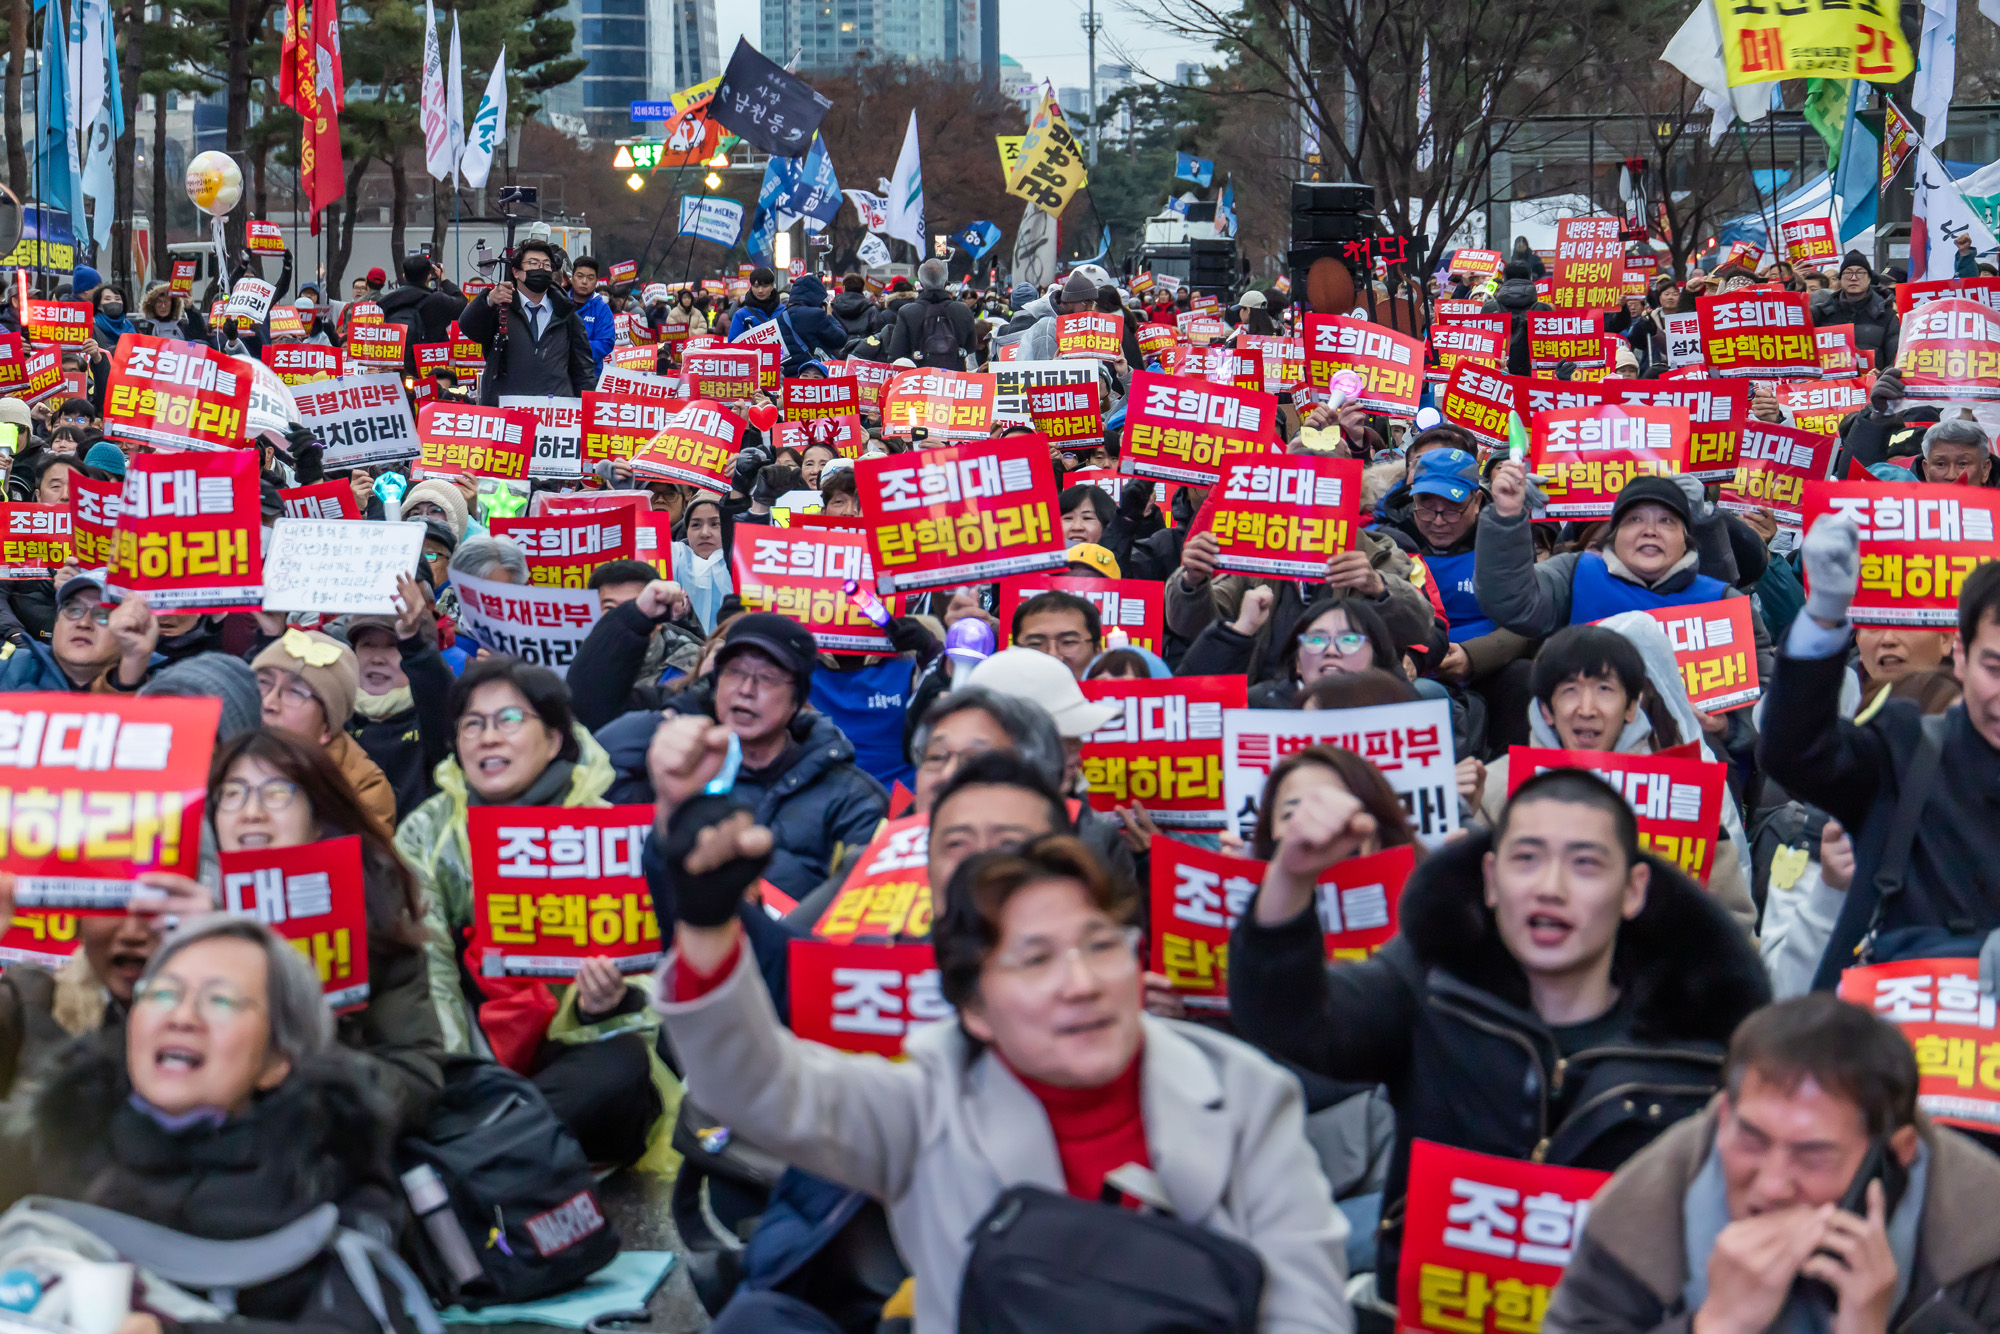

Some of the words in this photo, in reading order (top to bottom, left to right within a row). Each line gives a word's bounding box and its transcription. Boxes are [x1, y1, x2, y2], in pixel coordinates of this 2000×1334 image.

[756, 85, 780, 105] 사장
[634, 106, 661, 116] 지하차도
[735, 92, 784, 134] 남천동
[251, 237, 284, 249] 탄핵하라
[252, 224, 281, 235] 조희대
[1567, 222, 1595, 238] 내란당은
[1597, 221, 1619, 238] 국민을
[1344, 236, 1408, 269] 처단
[1459, 250, 1495, 261] 조희대를
[1560, 242, 1576, 259] 절대
[1578, 242, 1594, 259] 이길
[1595, 242, 1604, 259] 수
[1605, 241, 1622, 259] 없다
[1452, 260, 1494, 270] 탄핵하라!
[1565, 262, 1612, 282] 내란당이
[354, 305, 384, 316] 조희대
[1555, 287, 1573, 307] 퇴출
[32, 306, 85, 322] 조희대를
[1064, 317, 1117, 334] 조희대를
[1534, 317, 1594, 335] 조희대를
[1712, 301, 1804, 330] 조희대를
[1909, 311, 2000, 341] 조희대를
[29, 325, 88, 342] 탄핵하라!
[354, 326, 400, 341] 조희대를
[1060, 335, 1119, 352] 탄핵하라!
[1137, 327, 1171, 338] 조희대를
[1140, 338, 1175, 350] 탄핵하라!
[1315, 324, 1410, 365] 조희대를
[1433, 332, 1495, 353] 조희대를
[1817, 331, 1846, 348] 대를
[274, 351, 336, 369] 조희대를
[350, 344, 401, 359] 탄핵하라!
[616, 349, 652, 361] 조희대를
[1532, 339, 1600, 358] 탄핵하라!
[1708, 335, 1814, 363] 탄핵하라!
[1821, 350, 1852, 369] 하라!
[125, 345, 236, 396] 조희대를
[689, 359, 750, 376] 조희대를
[856, 366, 895, 383] 조희대
[299, 384, 399, 417] 특별재판부
[699, 382, 754, 399] 핵하라!
[790, 385, 851, 403] 조희대를
[899, 375, 983, 399] 조희대를
[1457, 367, 1515, 407] 조희대
[1788, 387, 1867, 411] 조희대를
[109, 384, 241, 439] 탄핵하라!
[890, 401, 986, 426] 탄핵하라!
[1031, 393, 1089, 413] 조희대를
[1144, 384, 1260, 431] 조희대를
[1446, 392, 1509, 435] 탄핵하
[431, 412, 523, 444] 조희대를
[676, 406, 734, 443] 희대를
[1034, 417, 1096, 437] 탄핵하라!
[1547, 417, 1671, 452] 조희대를
[587, 433, 652, 458] 탄핵하
[655, 433, 733, 475] 핵하라!
[1130, 424, 1265, 467] 탄핵하라!
[1741, 428, 1814, 469] 희대를
[421, 442, 525, 478] 탄핵하라!
[121, 469, 234, 518] 희대를
[877, 455, 1032, 512] 조희대를
[1224, 465, 1342, 506] 조희대를
[1735, 466, 1803, 505] 핵하라
[9, 511, 71, 535] 조희대
[1211, 510, 1347, 555] 탄핵하라!
[1829, 497, 1993, 541] 조희대를
[876, 502, 1052, 565] 탄핵하라!
[4, 541, 71, 564] 탄핵하
[107, 528, 249, 578] 핵하라!
[751, 538, 873, 581] 조희대
[458, 584, 593, 627] 특별재판부
[1666, 617, 1732, 652] 대를
[1679, 652, 1746, 697] 하라!
[1082, 695, 1223, 742] 희대를
[0, 710, 172, 770] 희대를
[1083, 756, 1223, 799] 핵하라
[0, 788, 183, 865] 하라!
[497, 825, 650, 879] 조희대
[225, 867, 332, 924] 대를
[487, 893, 662, 947] 탄핵하
[529, 1192, 604, 1253] MARVEL
[1443, 1177, 1590, 1263] 조희
